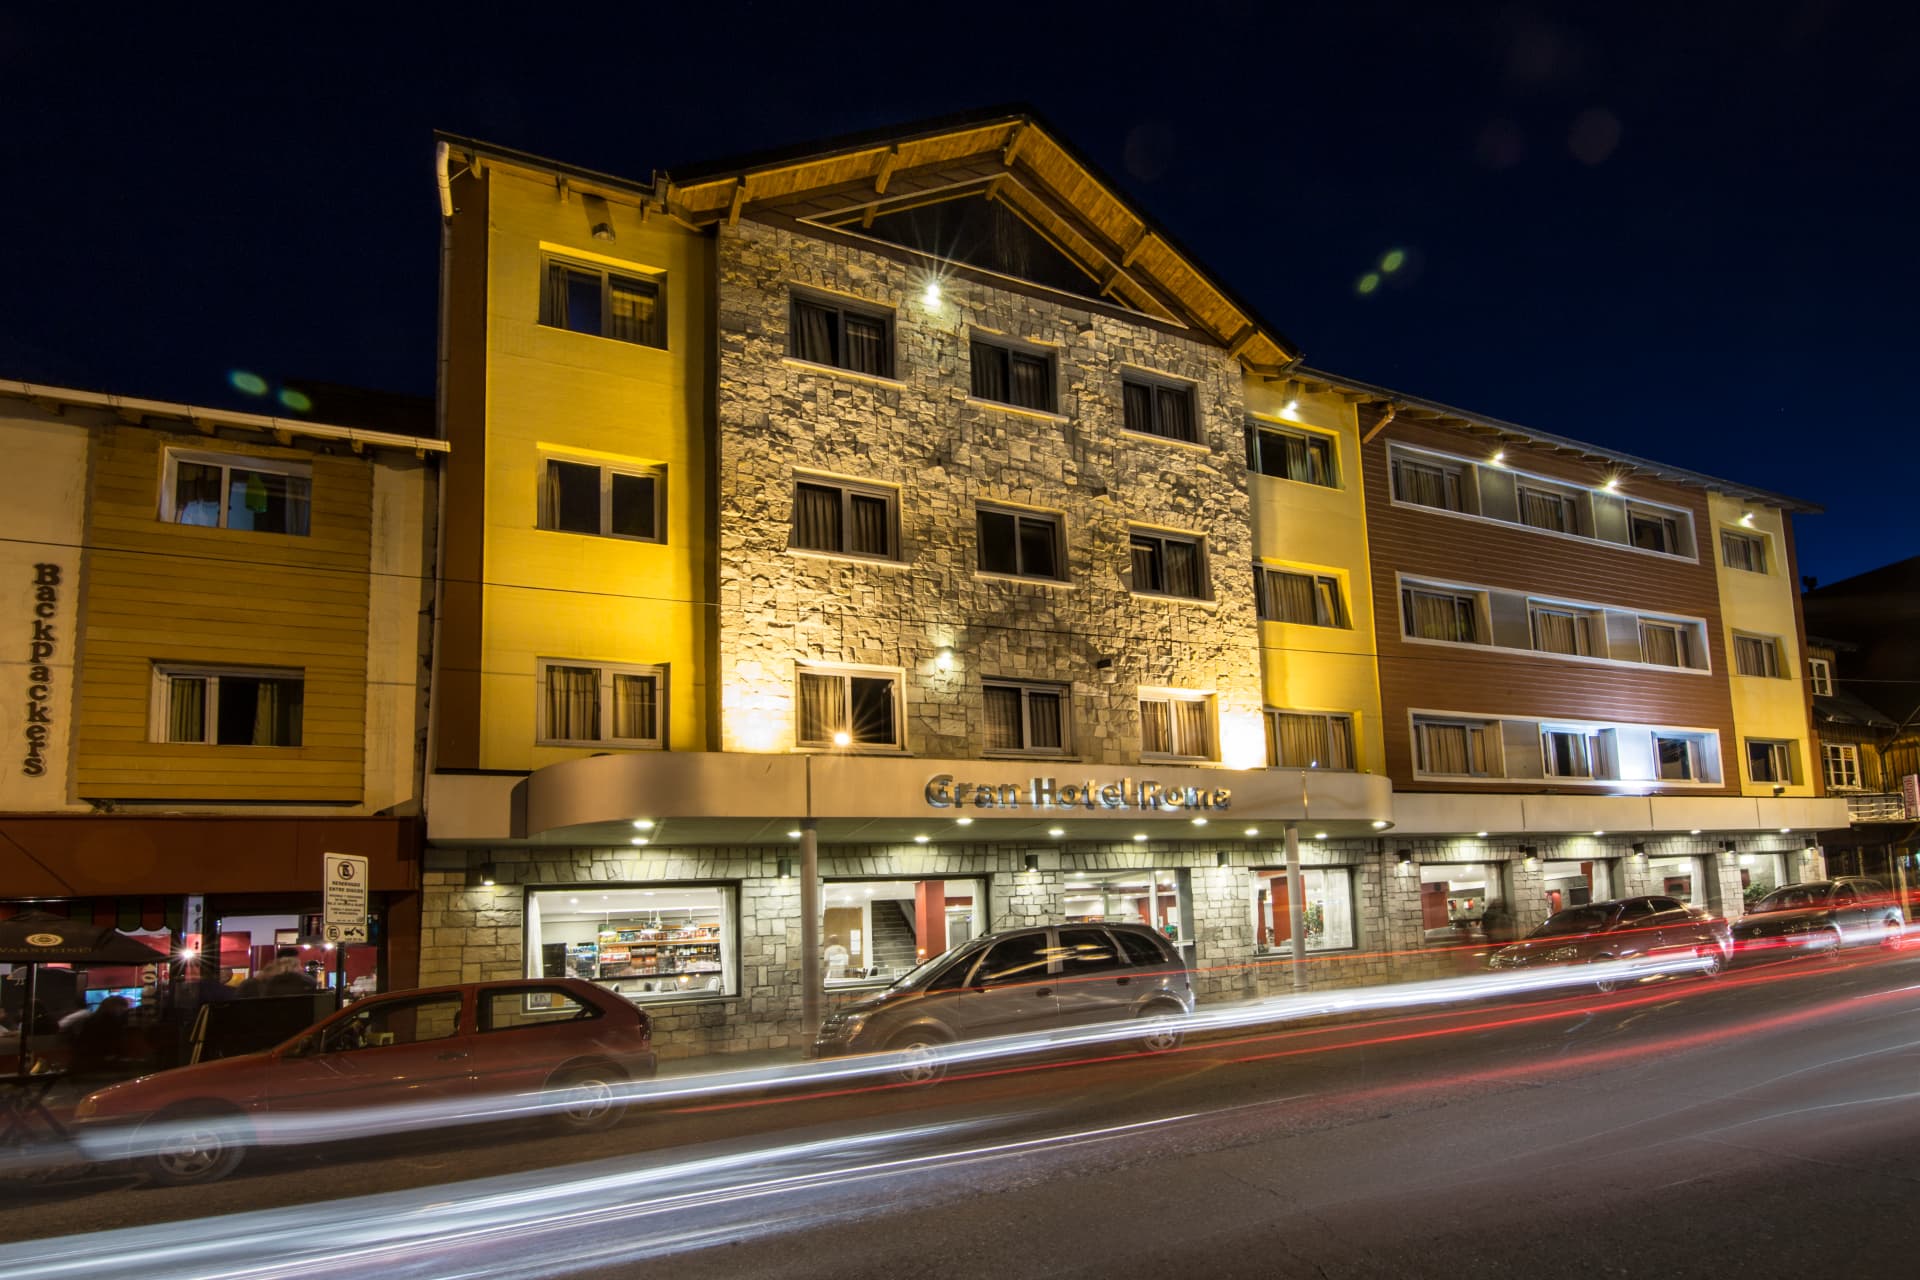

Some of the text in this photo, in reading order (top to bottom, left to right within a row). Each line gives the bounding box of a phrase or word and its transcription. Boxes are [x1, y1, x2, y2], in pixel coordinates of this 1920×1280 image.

[23, 563, 62, 776] Backpackers
[925, 774, 1232, 811] Gran Hotel Roma
